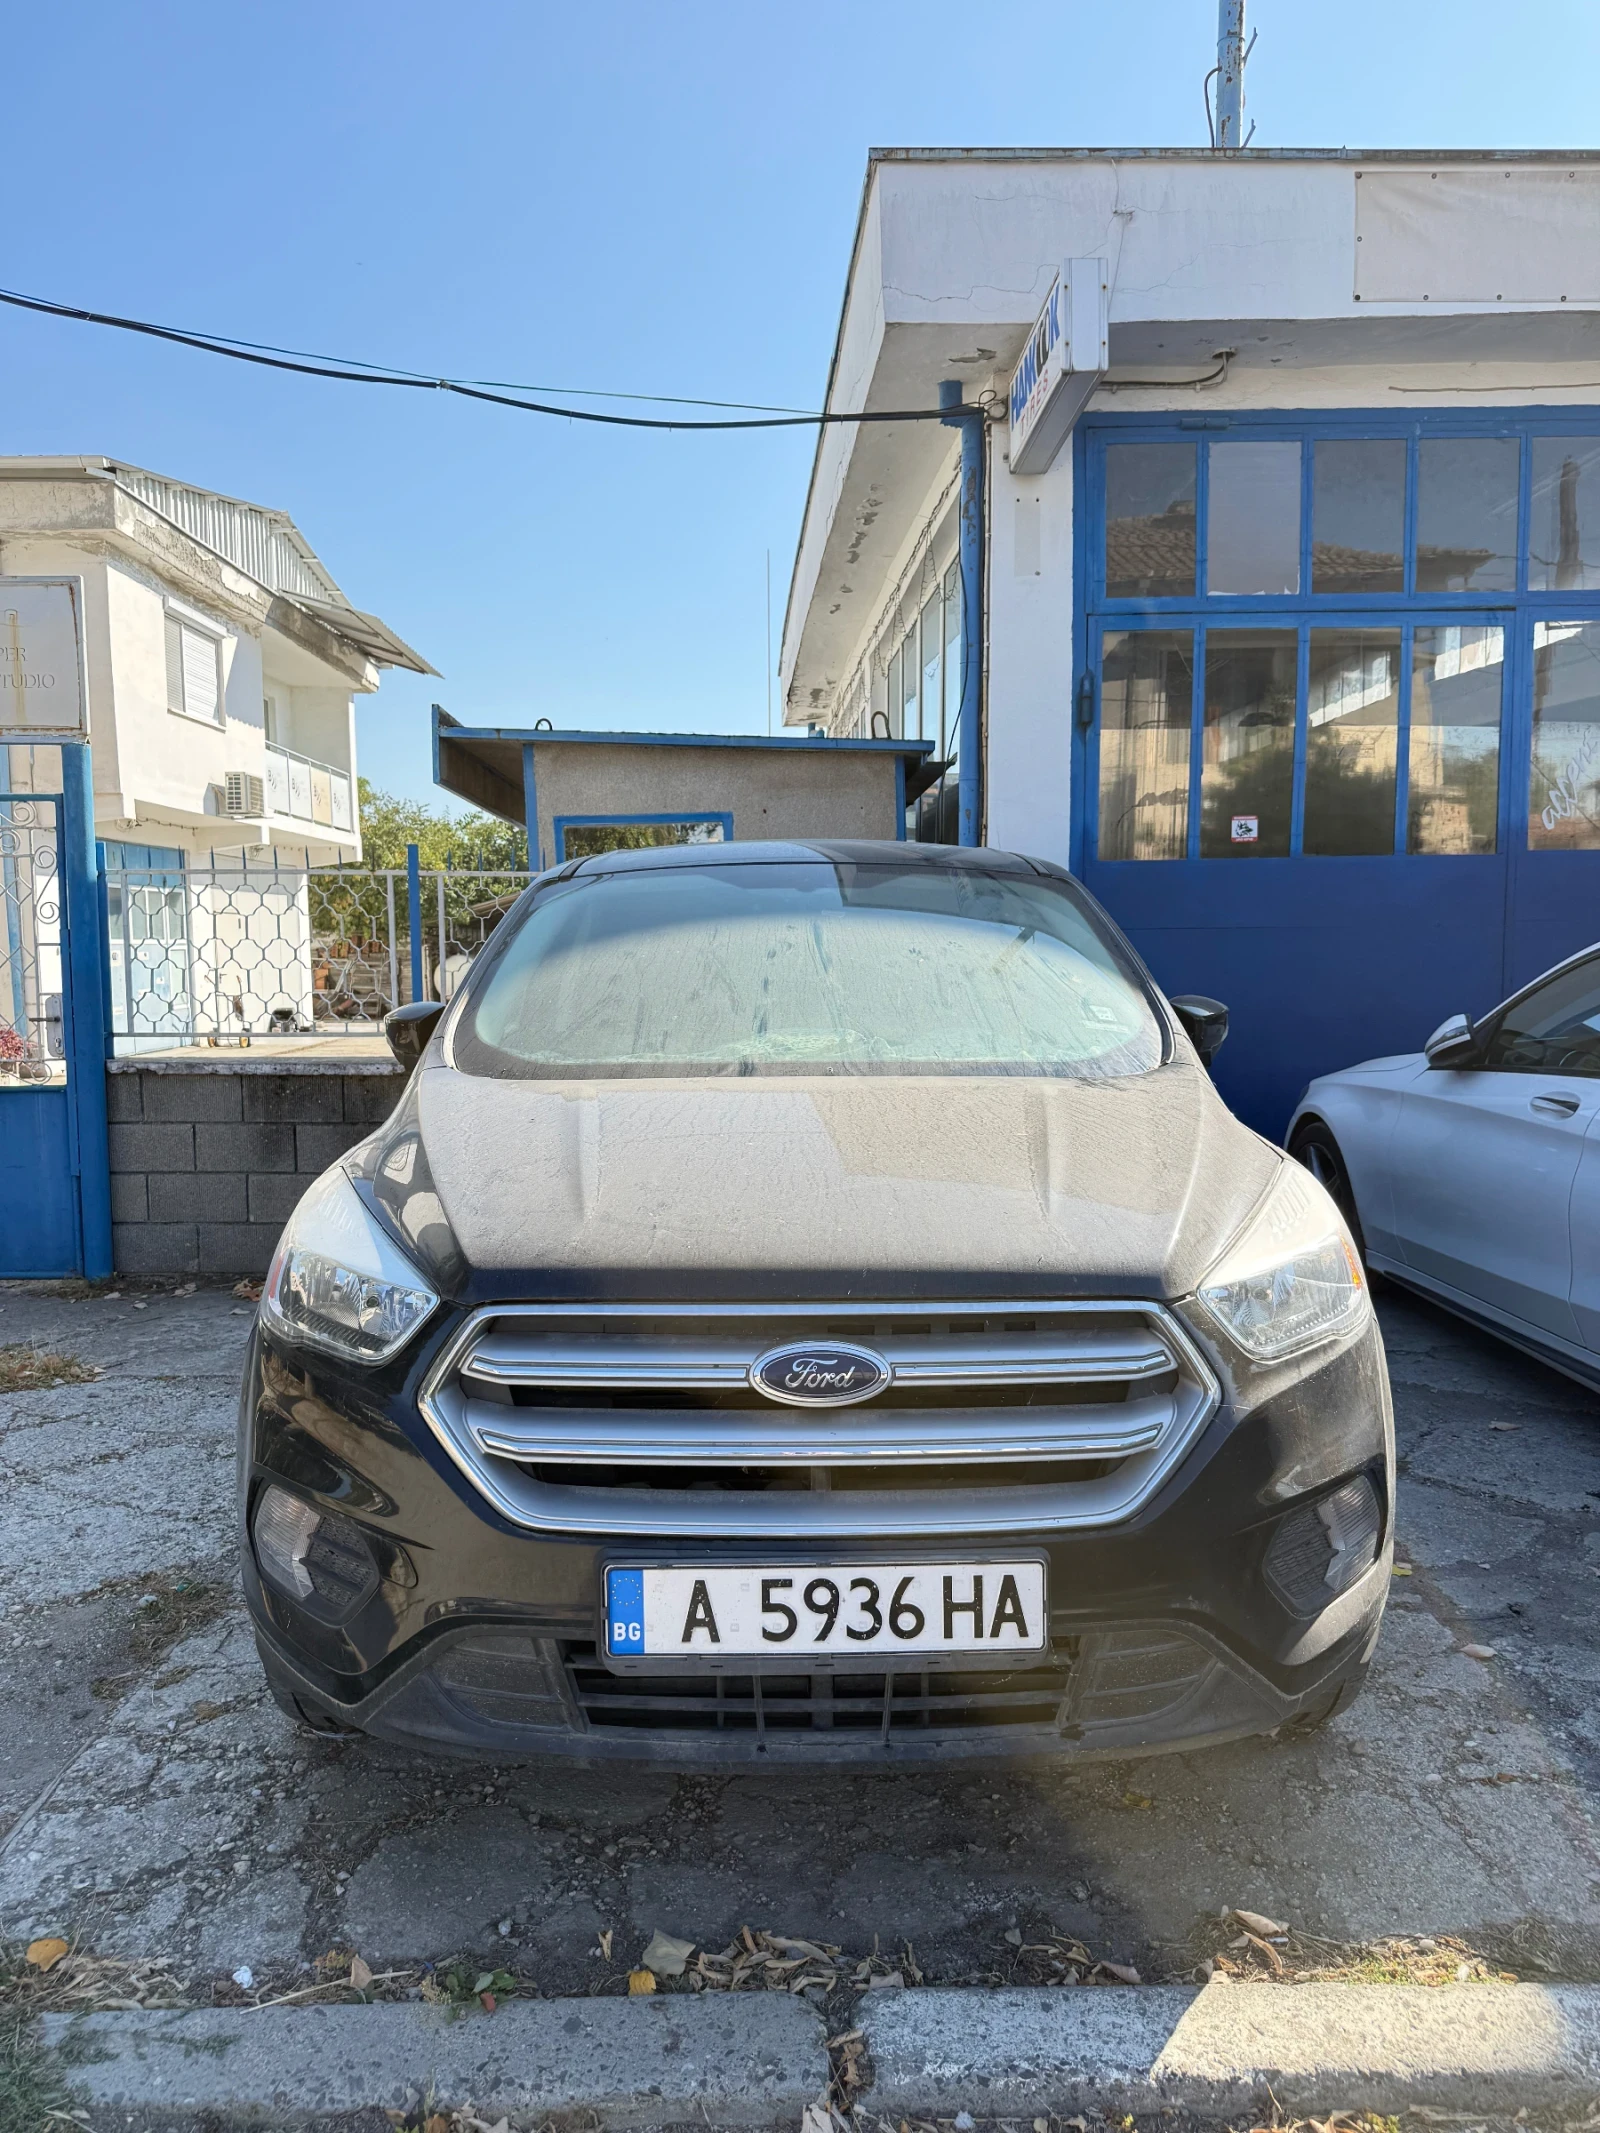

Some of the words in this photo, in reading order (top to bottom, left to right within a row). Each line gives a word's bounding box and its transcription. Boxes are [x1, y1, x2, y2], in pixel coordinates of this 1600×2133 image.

[1020, 369, 1049, 437] TIRES
[0, 673, 55, 689] TUDIO
[785, 1358, 855, 1388] Ford
[681, 1579, 721, 1643] A
[761, 1576, 925, 1642] 5936
[942, 1575, 1029, 1639] HA
[613, 1622, 641, 1641] BG
